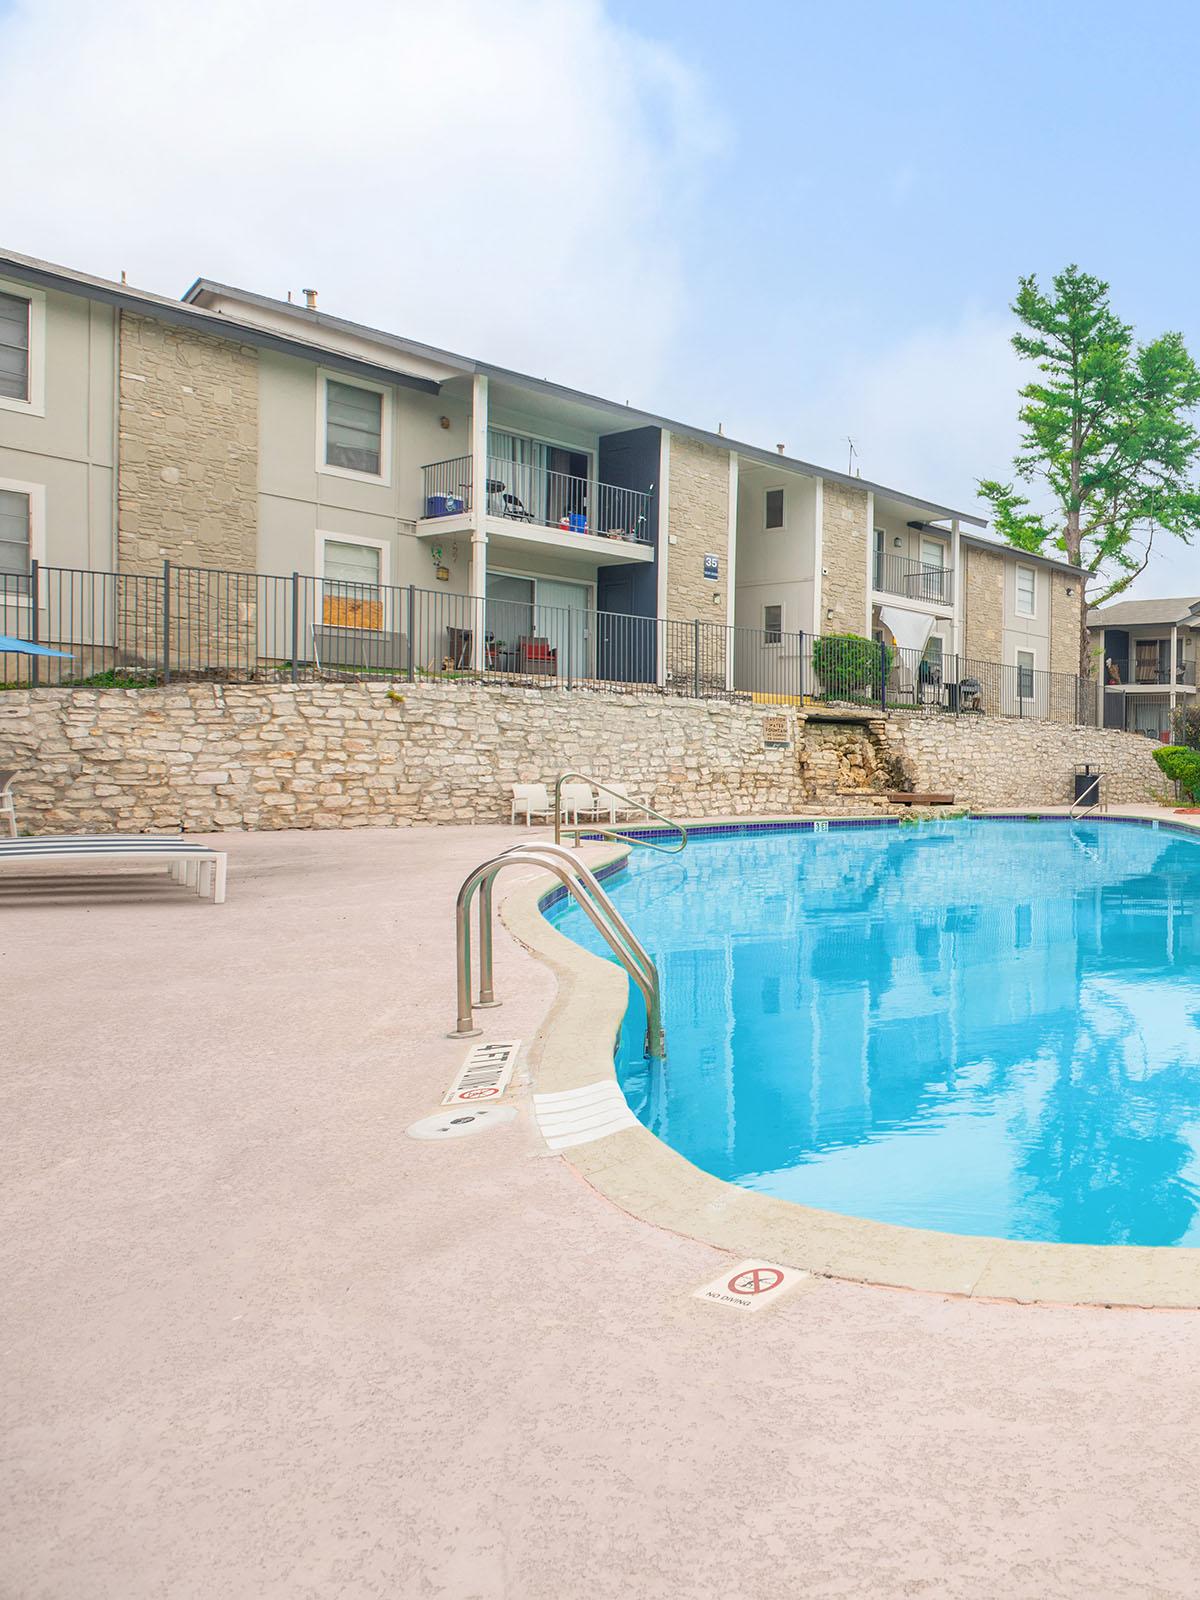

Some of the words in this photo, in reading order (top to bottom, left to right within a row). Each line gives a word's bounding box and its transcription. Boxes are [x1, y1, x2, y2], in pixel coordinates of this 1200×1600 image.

[705, 557, 718, 568] 35
[705, 1291, 721, 1299] NO
[720, 1294, 752, 1307] DIVING
